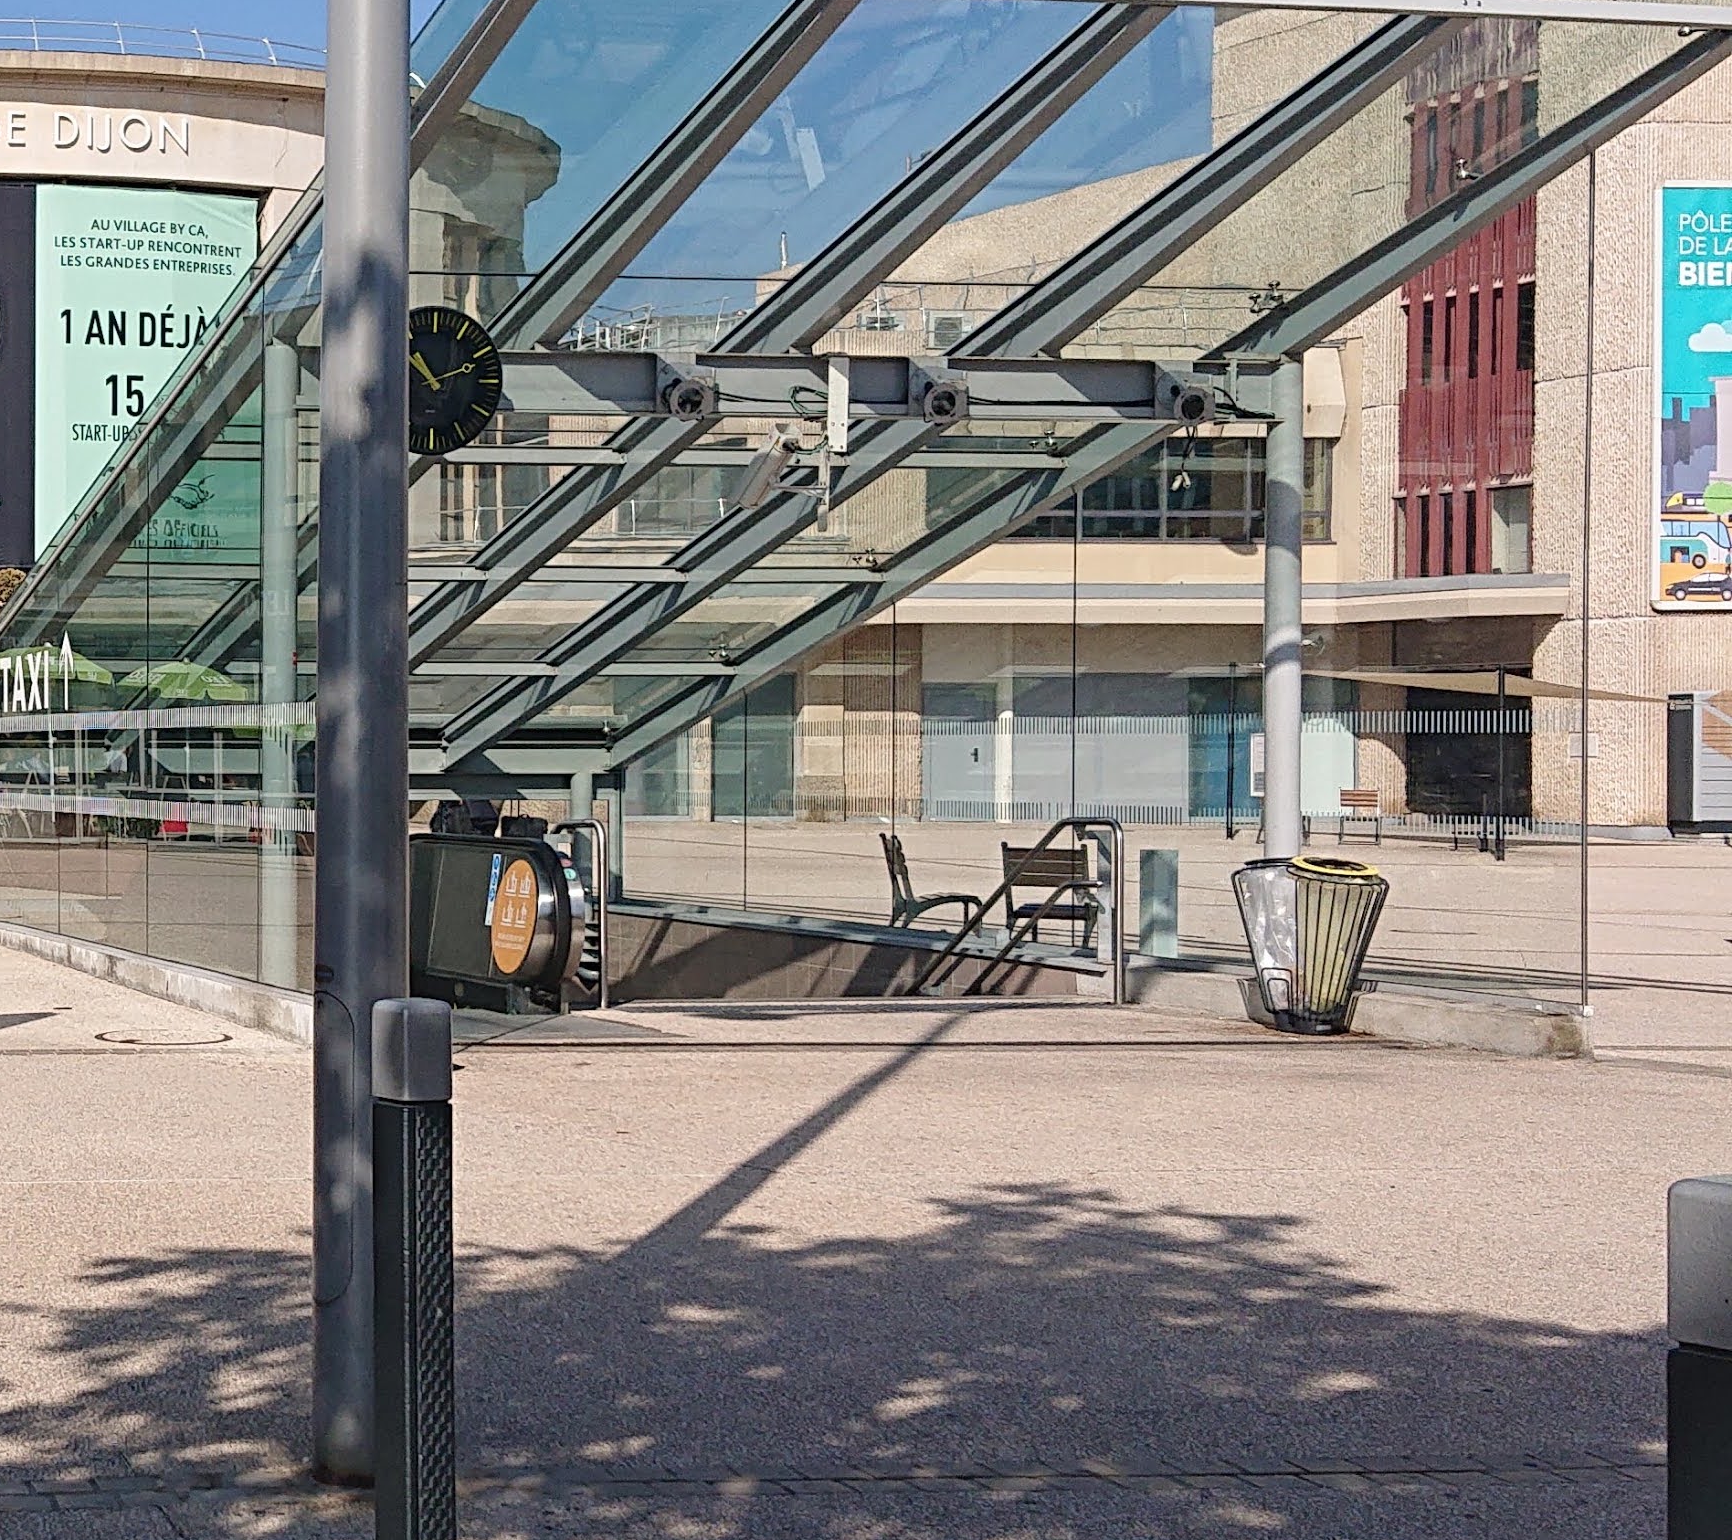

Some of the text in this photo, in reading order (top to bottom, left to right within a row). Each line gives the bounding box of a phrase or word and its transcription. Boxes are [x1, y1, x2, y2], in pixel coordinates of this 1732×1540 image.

[53, 111, 190, 156] DIJON
[91, 219, 209, 239] AU VILLAGE BY CA,
[1679, 210, 1732, 233] PÔLE
[54, 236, 242, 258] LES START-UP RENCONTRENT
[1679, 236, 1707, 255] DE
[60, 255, 236, 276] LES GRANDES ENTREPRISES.
[60, 309, 72, 344] 1
[84, 310, 126, 346] AN
[105, 374, 144, 417] 15
[0, 650, 49, 712] TAXI
